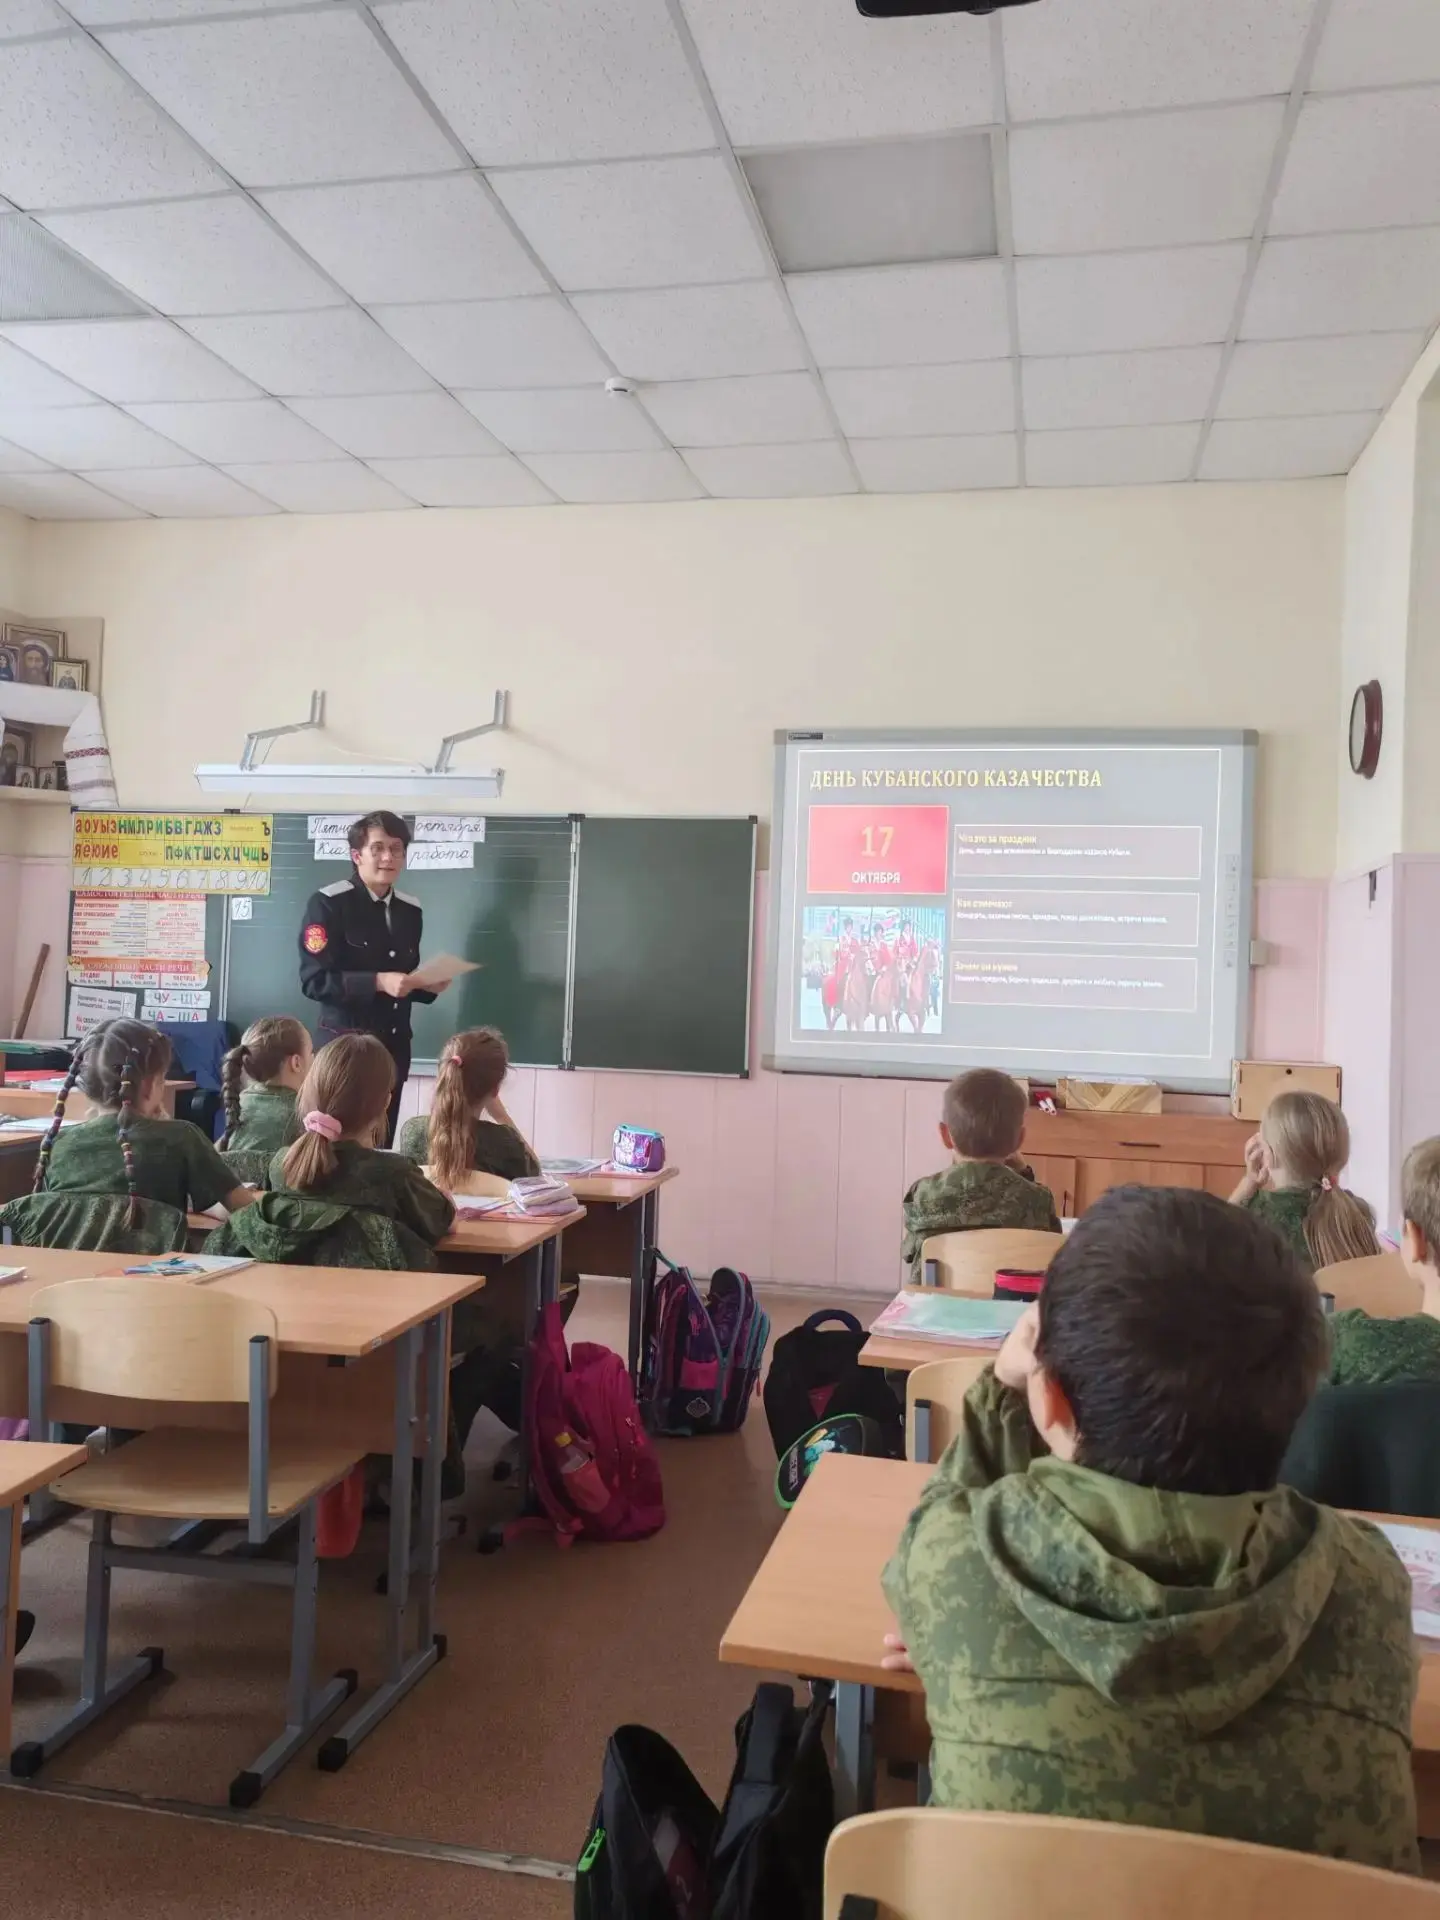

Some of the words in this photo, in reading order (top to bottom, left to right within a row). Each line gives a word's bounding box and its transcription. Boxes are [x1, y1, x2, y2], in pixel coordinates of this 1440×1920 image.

[810, 770, 855, 789] ДЕНЬ
[861, 769, 979, 788] КУБАНСКОГО
[983, 769, 1102, 788] КАЗАЧЕСТВА
[861, 825, 894, 857] 17
[852, 872, 901, 884] ОКТЯБРЯ
